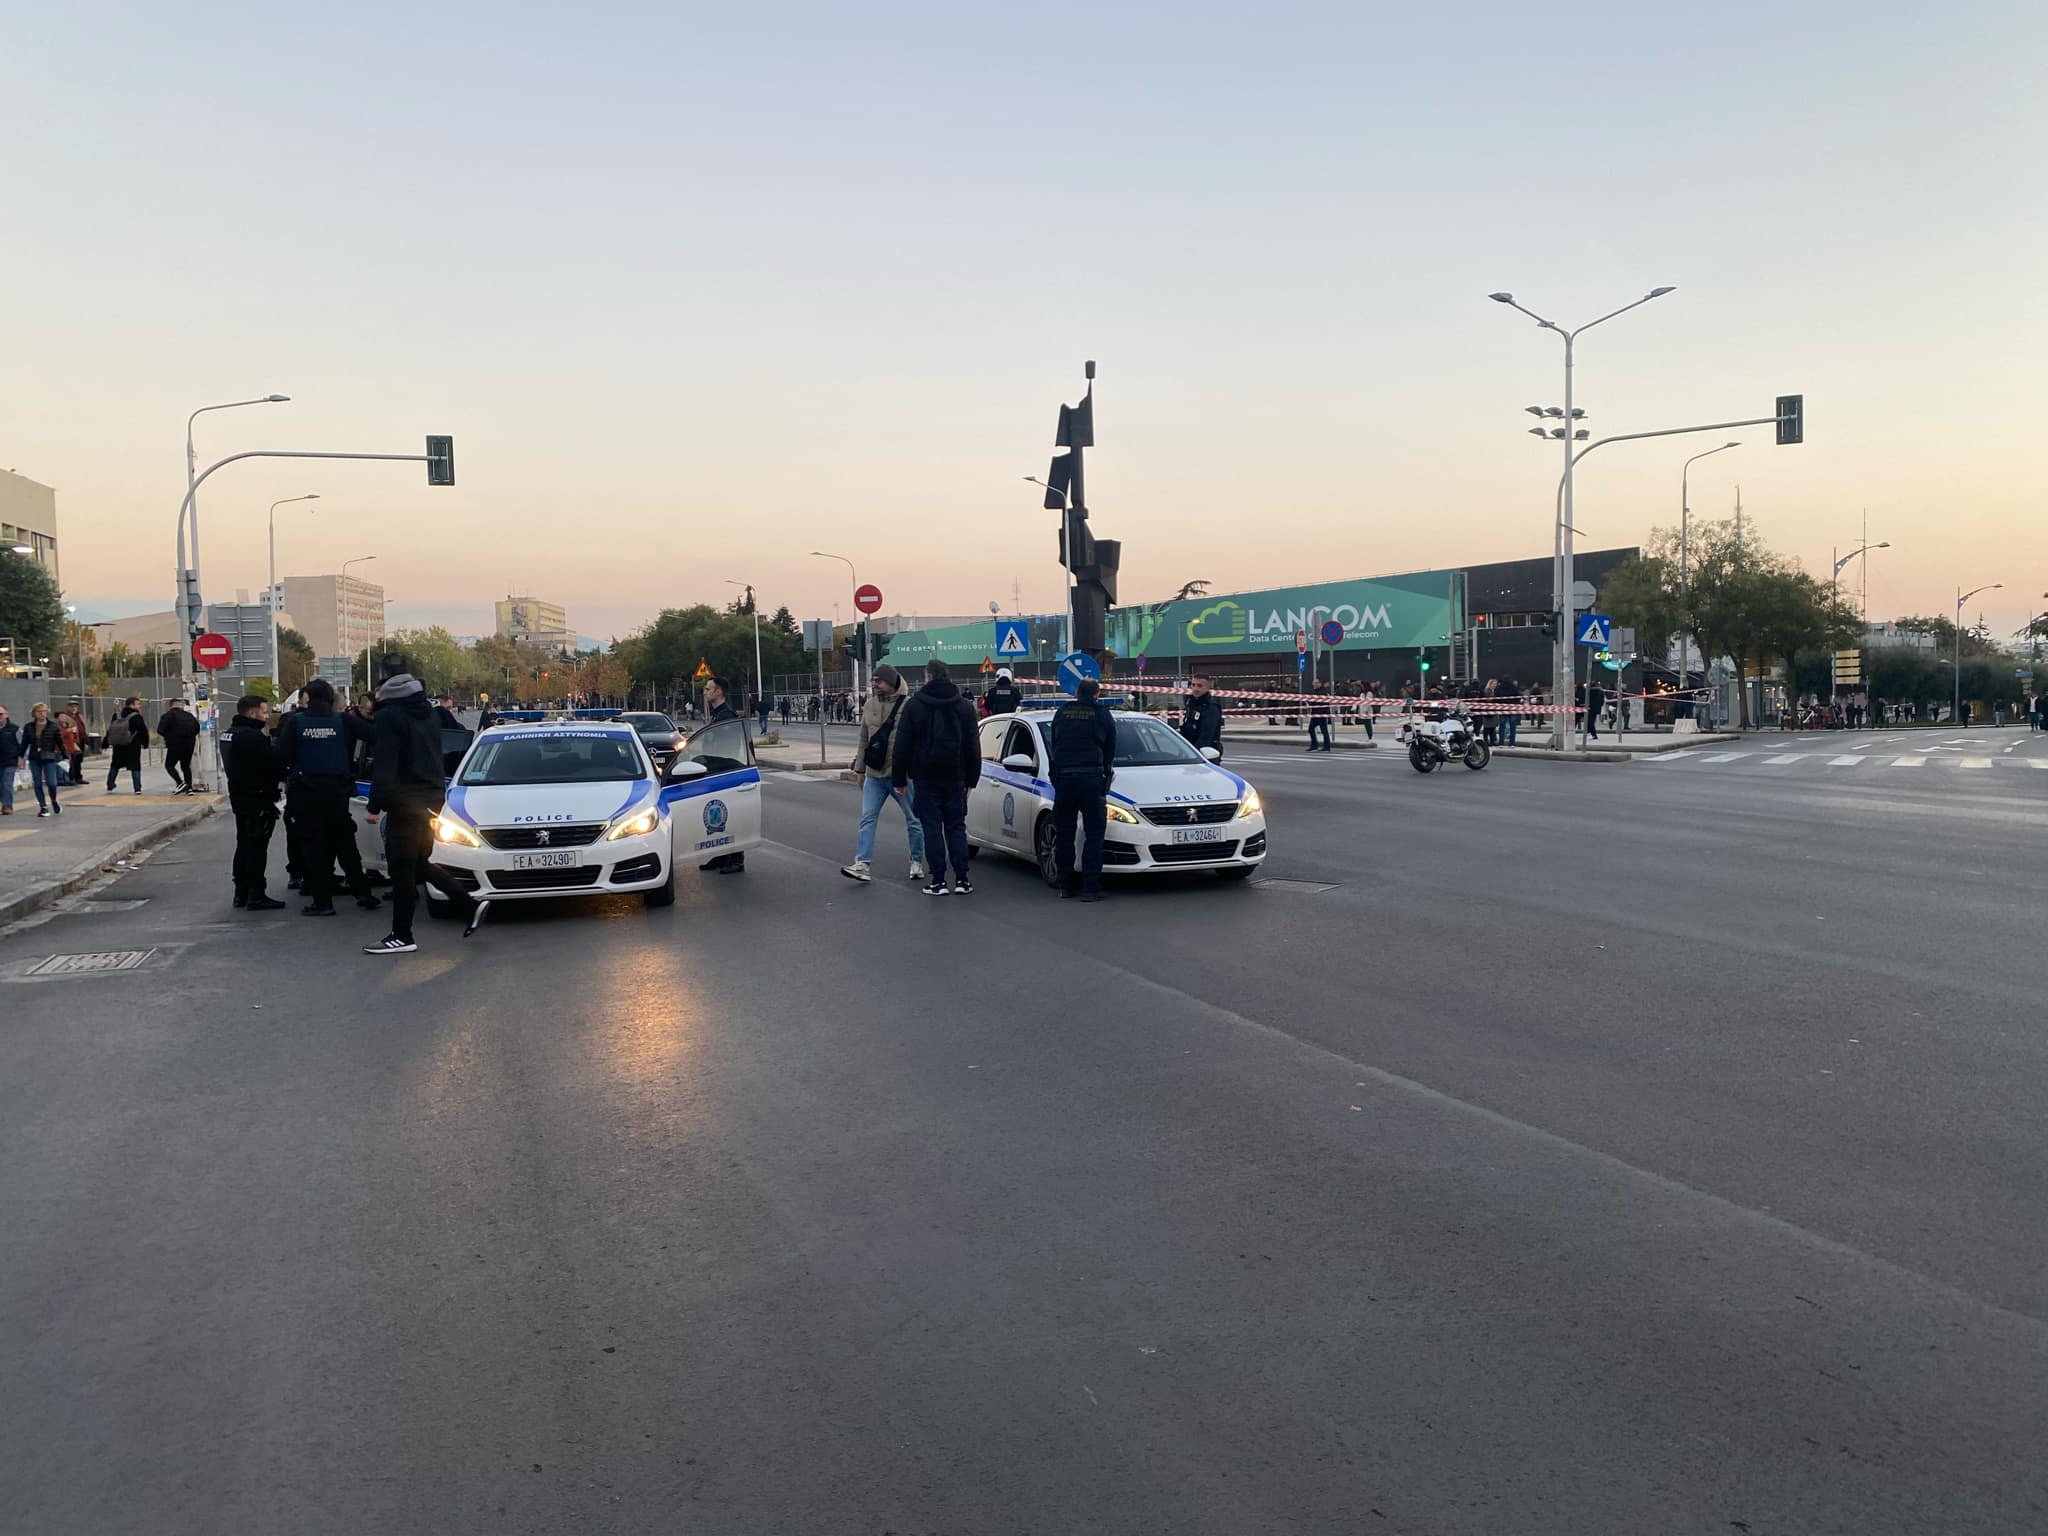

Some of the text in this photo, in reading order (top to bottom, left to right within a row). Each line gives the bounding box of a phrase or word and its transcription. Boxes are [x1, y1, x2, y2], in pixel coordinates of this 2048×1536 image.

[1249, 604, 1392, 634] LANCOM
[1250, 634, 1270, 643] Data
[939, 643, 987, 651] TECHNOLOGY
[504, 732, 551, 740] ΕΛΛΗΝΙΚΗ
[514, 814, 574, 822] POLICE
[700, 836, 730, 850] POLICE
[541, 853, 570, 867] 32490
